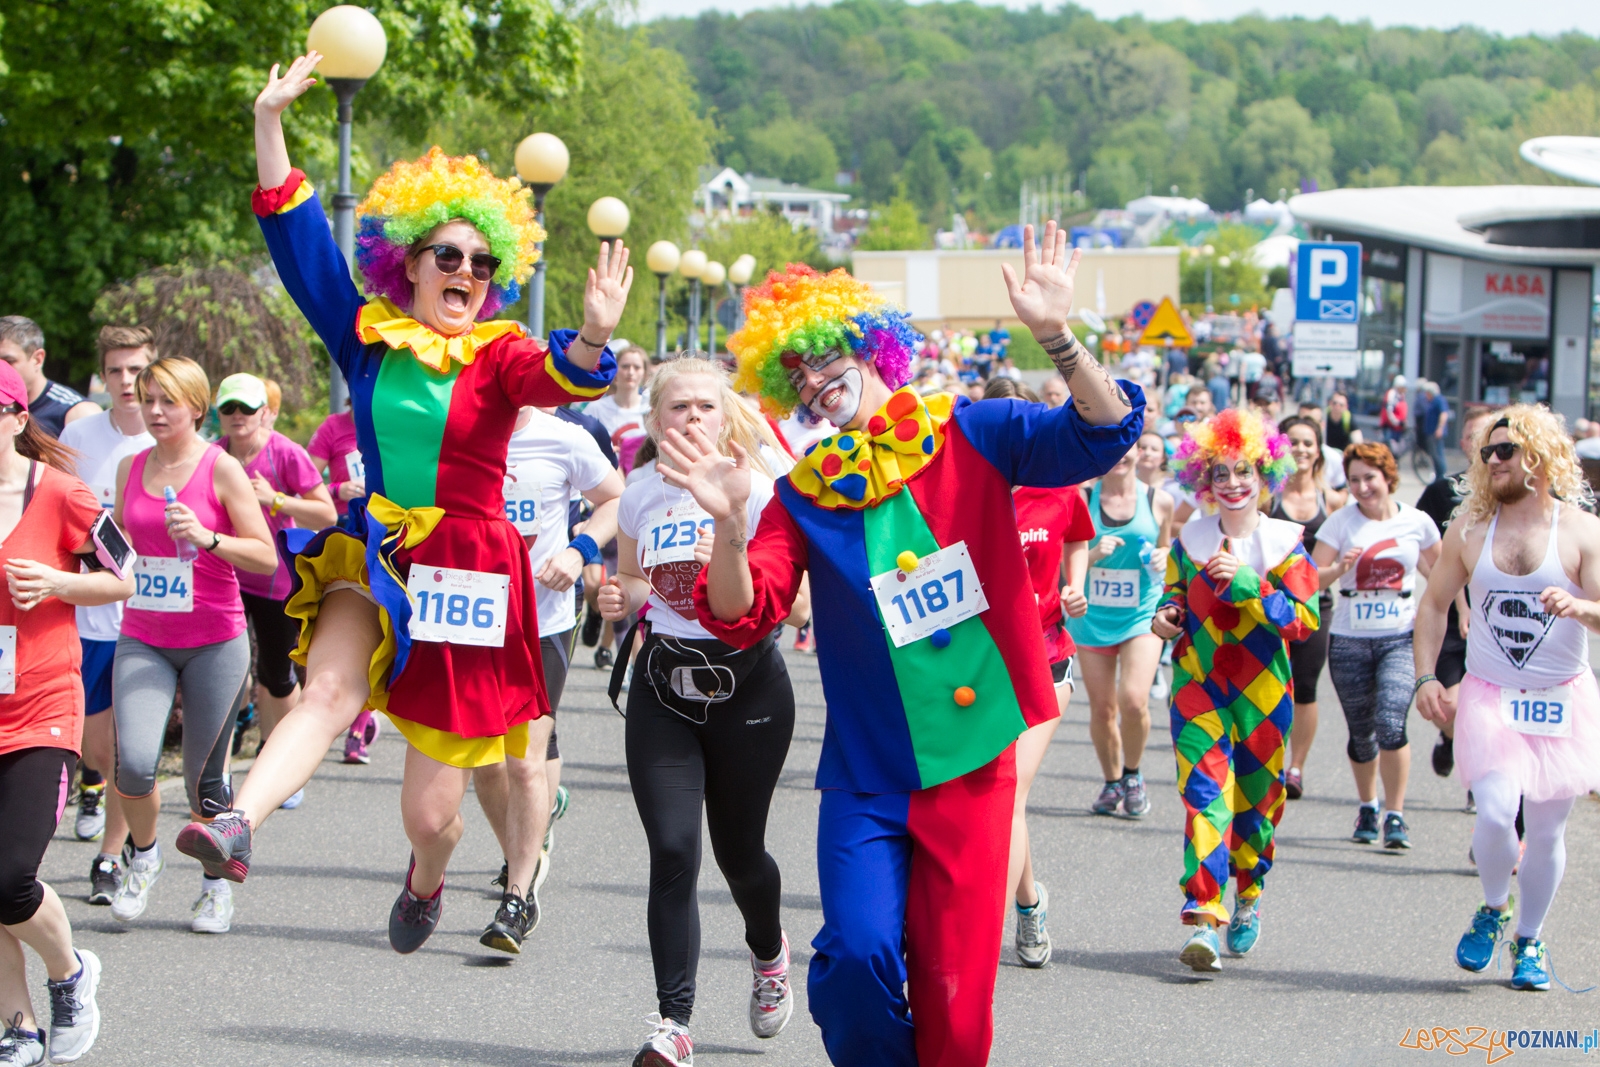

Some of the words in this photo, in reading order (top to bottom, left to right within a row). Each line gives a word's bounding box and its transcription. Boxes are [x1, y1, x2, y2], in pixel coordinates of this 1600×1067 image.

[1309, 248, 1348, 300] P
[1486, 273, 1545, 296] KASA
[504, 500, 535, 522] 58
[1018, 528, 1049, 546] pirit
[135, 573, 187, 598] 1294
[679, 581, 696, 595] ta
[891, 569, 964, 625] 1187
[1094, 580, 1134, 598] 1733
[417, 590, 495, 628] 1186
[1355, 602, 1399, 620] 1794
[1510, 700, 1564, 724] 1183
